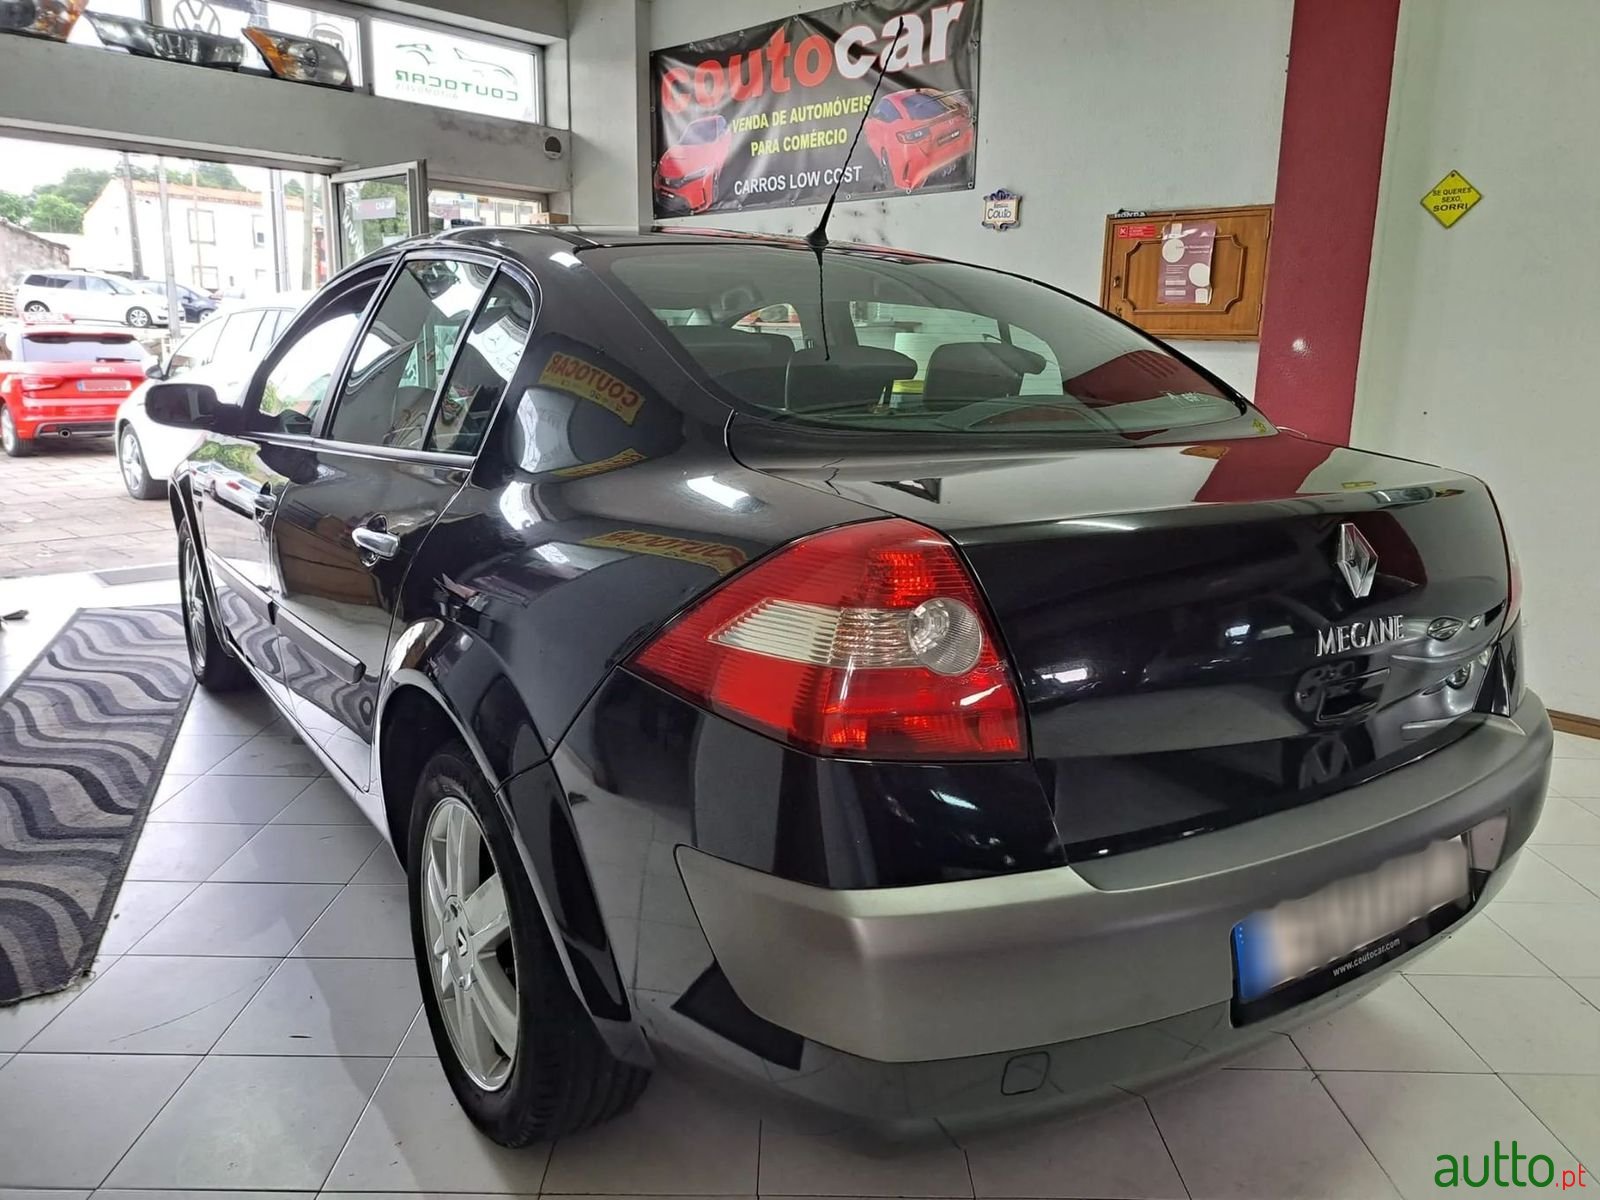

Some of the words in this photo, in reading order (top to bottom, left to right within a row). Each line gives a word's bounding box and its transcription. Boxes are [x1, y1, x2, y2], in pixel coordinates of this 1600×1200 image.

[661, 1, 963, 113] coutocar
[733, 114, 768, 133] VENDA
[772, 110, 787, 126] DE
[790, 95, 872, 123] AUTOMÓVEIS
[751, 139, 780, 156] PARA
[783, 128, 847, 152] COMÉRCIO
[734, 175, 786, 195] CARROS
[790, 171, 820, 189] LOW
[824, 166, 862, 185] COST
[1443, 187, 1472, 195] QUERES
[1433, 203, 1468, 212] SORRI
[1314, 615, 1404, 656] MEGANE
[1333, 938, 1400, 976] www.coutocar.com
